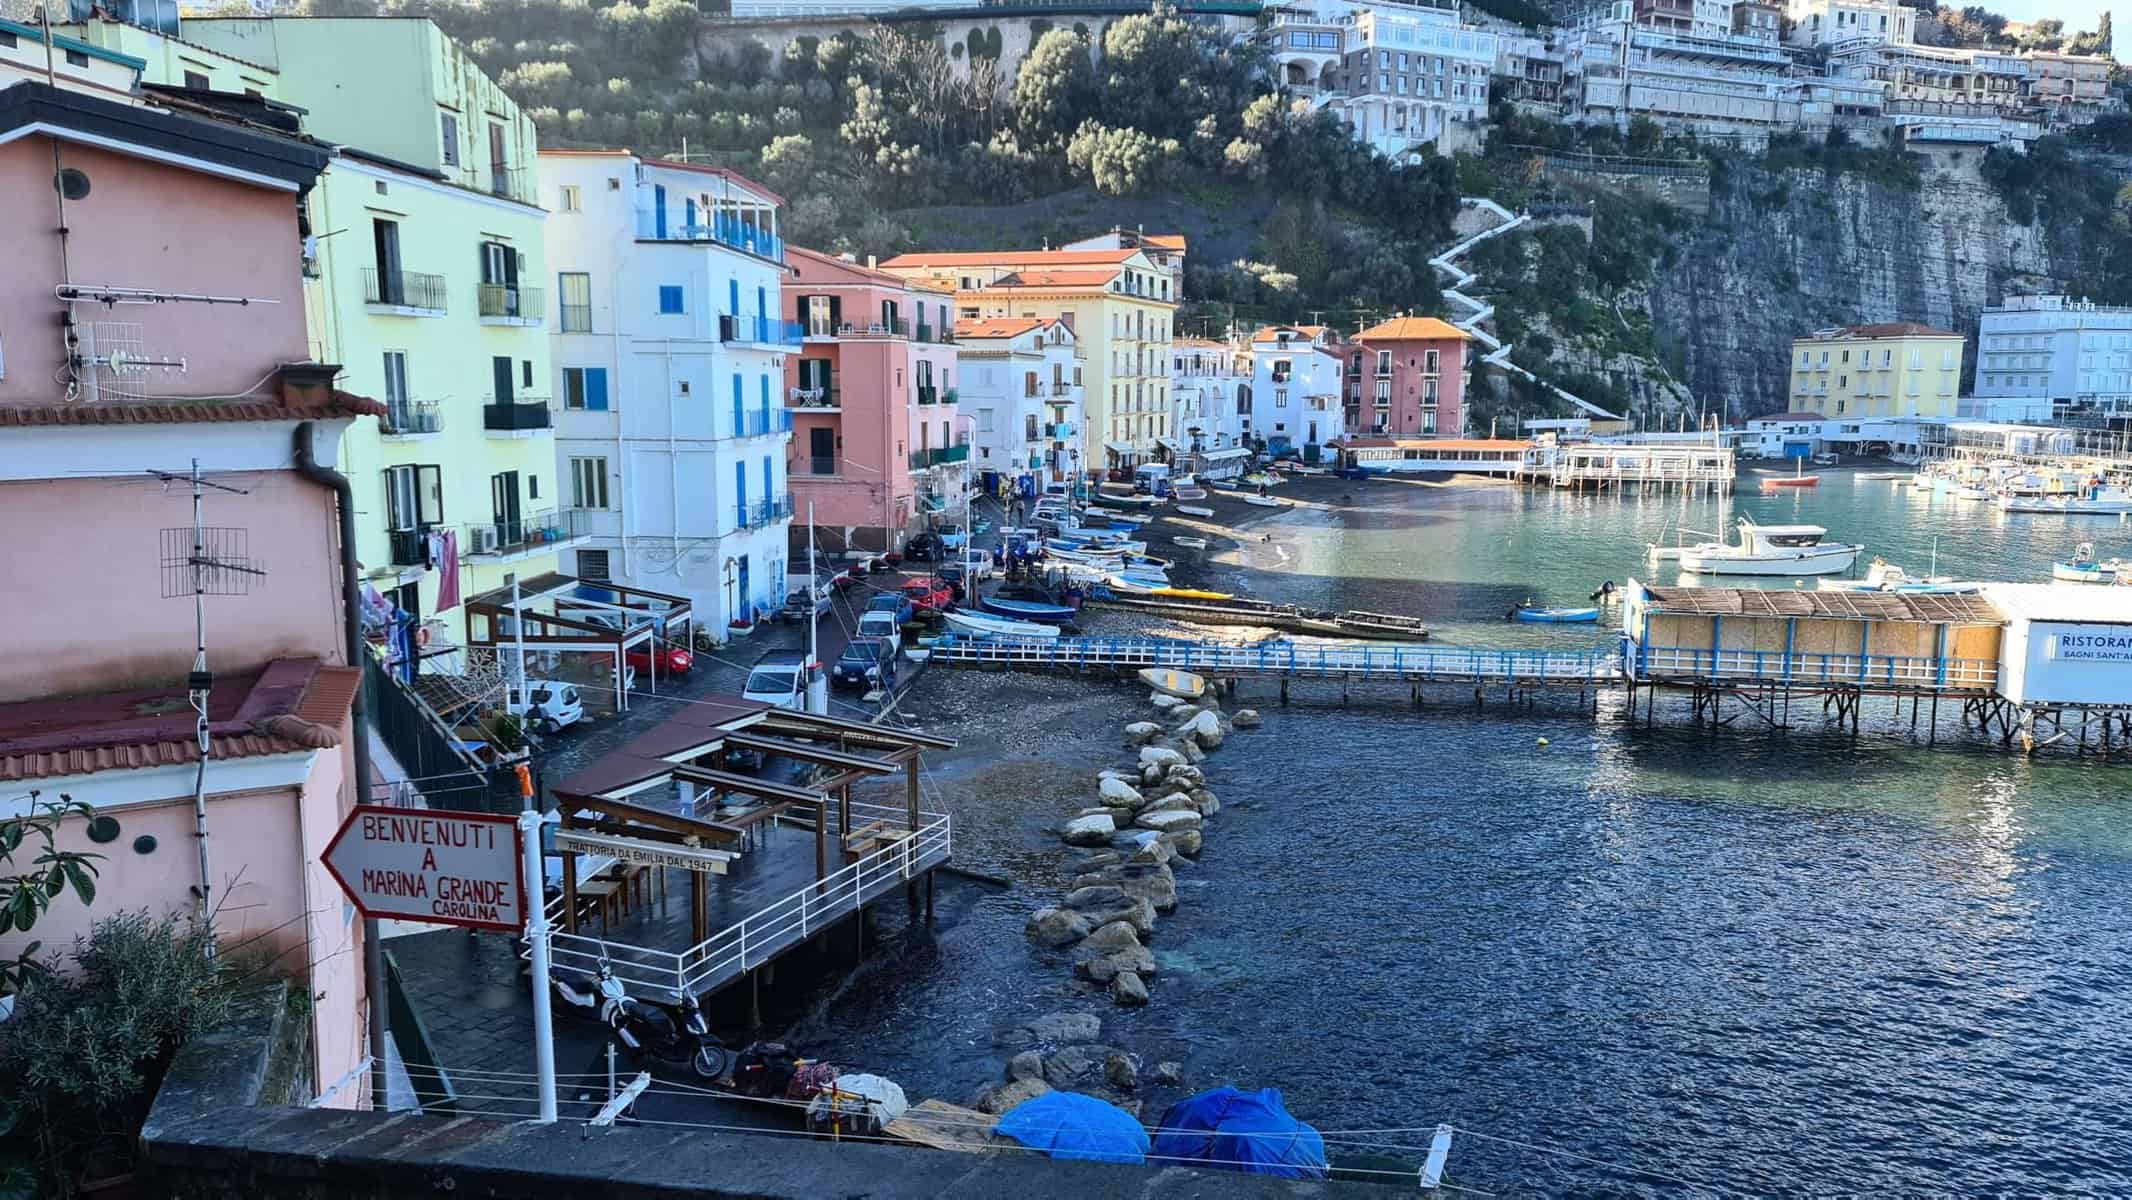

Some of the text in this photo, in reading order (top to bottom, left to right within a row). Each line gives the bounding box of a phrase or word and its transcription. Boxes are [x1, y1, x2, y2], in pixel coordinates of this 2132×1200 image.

[2064, 651, 2093, 659] BAGNI
[363, 816, 493, 849] BENVENUTI
[422, 848, 437, 871] A
[567, 841, 713, 871] TRATTORIA DA EMILIA DAL 1947
[362, 869, 511, 906] MARINA GRANDE
[432, 900, 500, 921] CAROLINA
